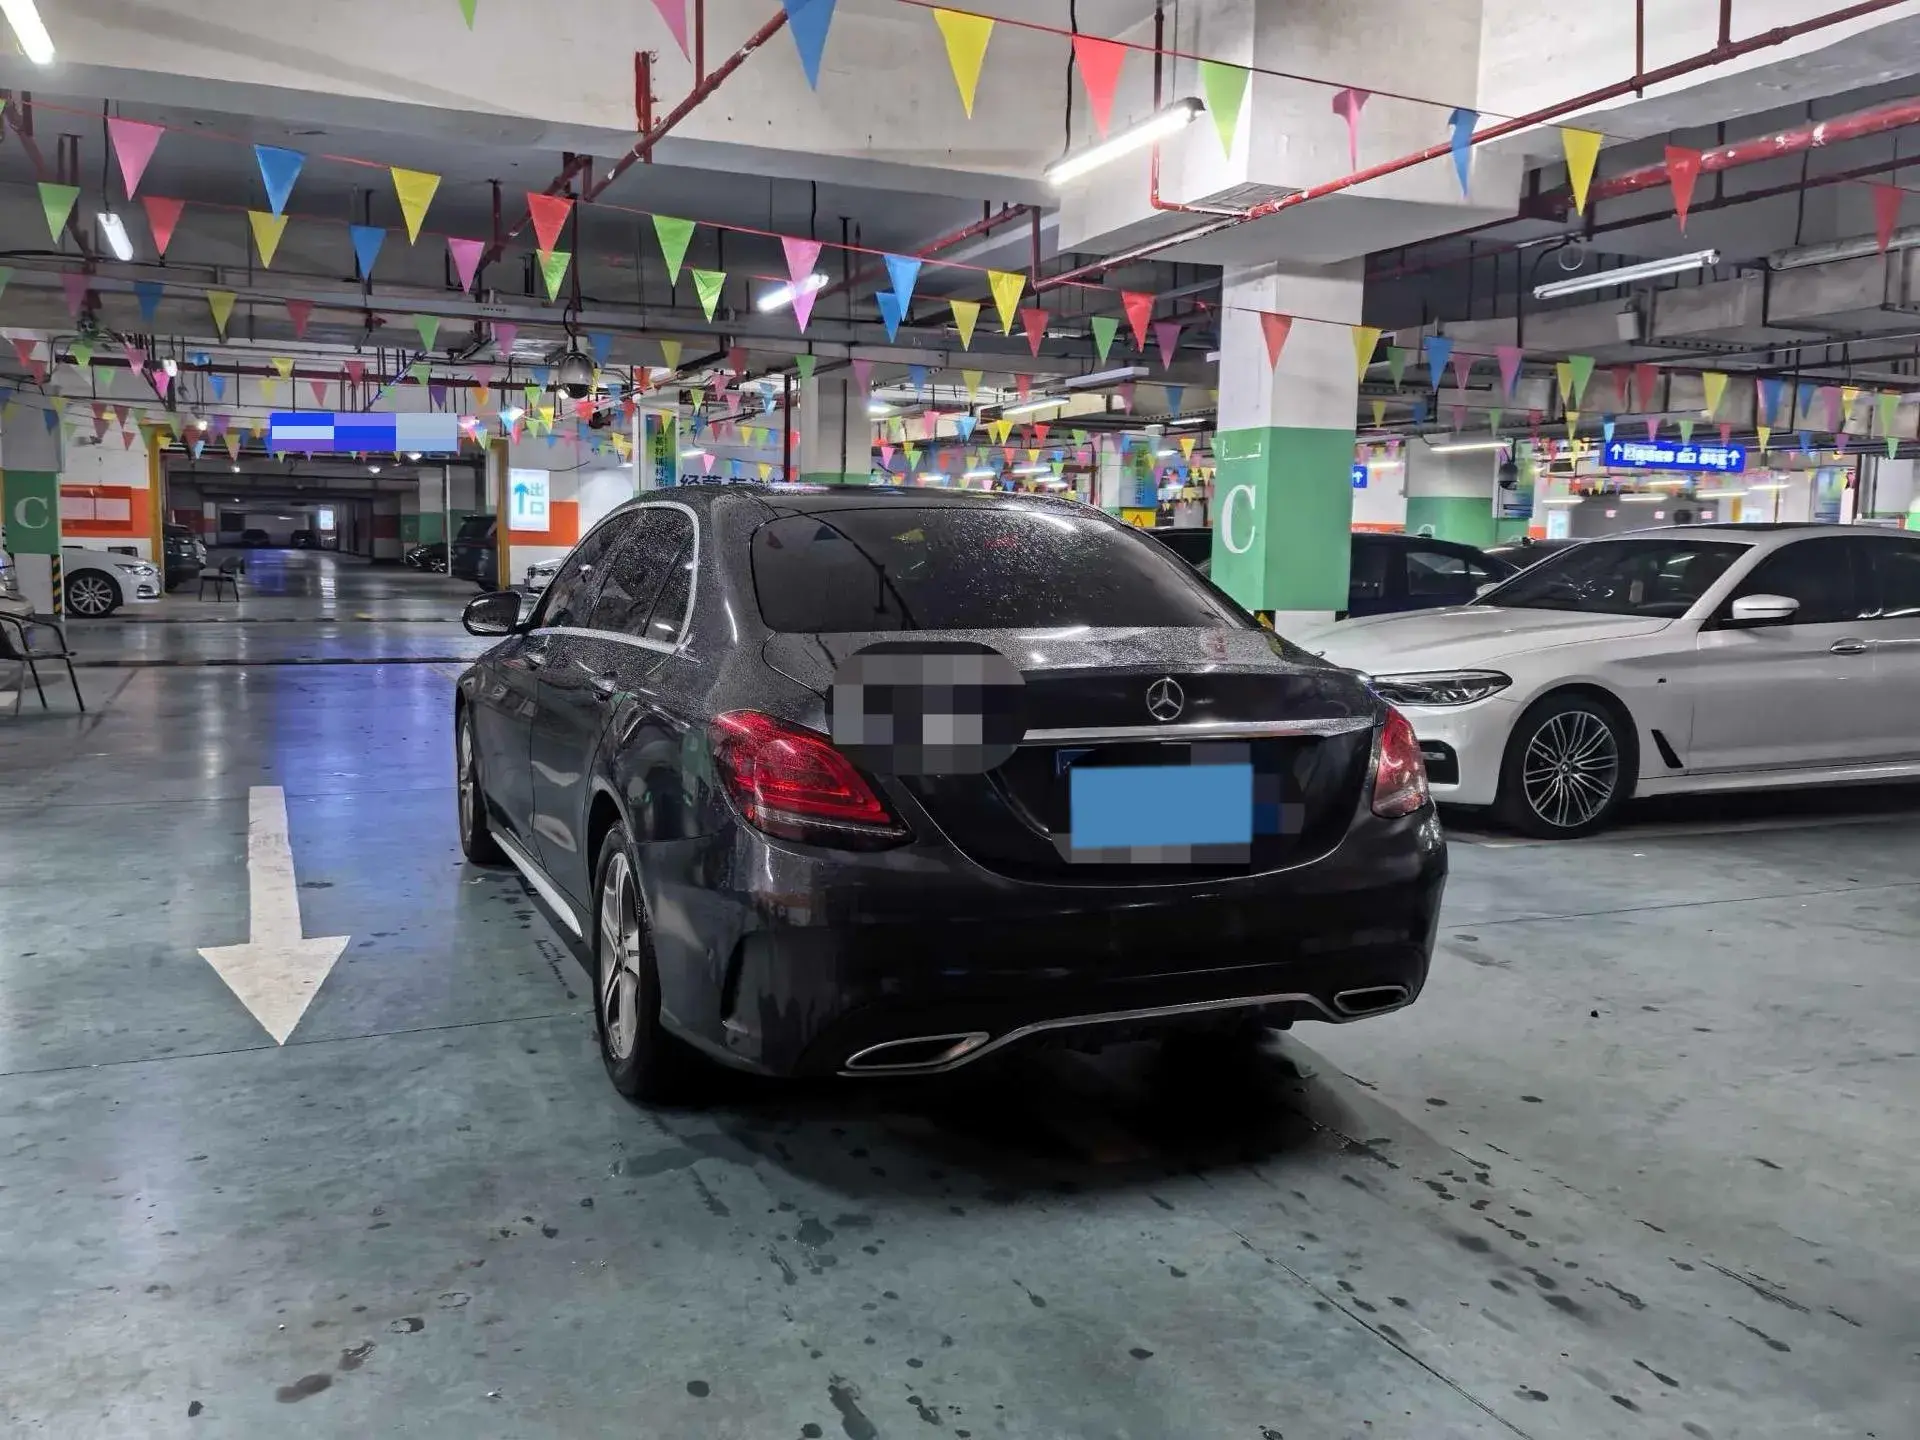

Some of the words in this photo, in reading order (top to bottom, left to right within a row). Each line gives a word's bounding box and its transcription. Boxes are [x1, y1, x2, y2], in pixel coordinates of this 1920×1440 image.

[14, 496, 50, 530] C
[530, 481, 545, 515] 出口
[1221, 484, 1257, 554] C
